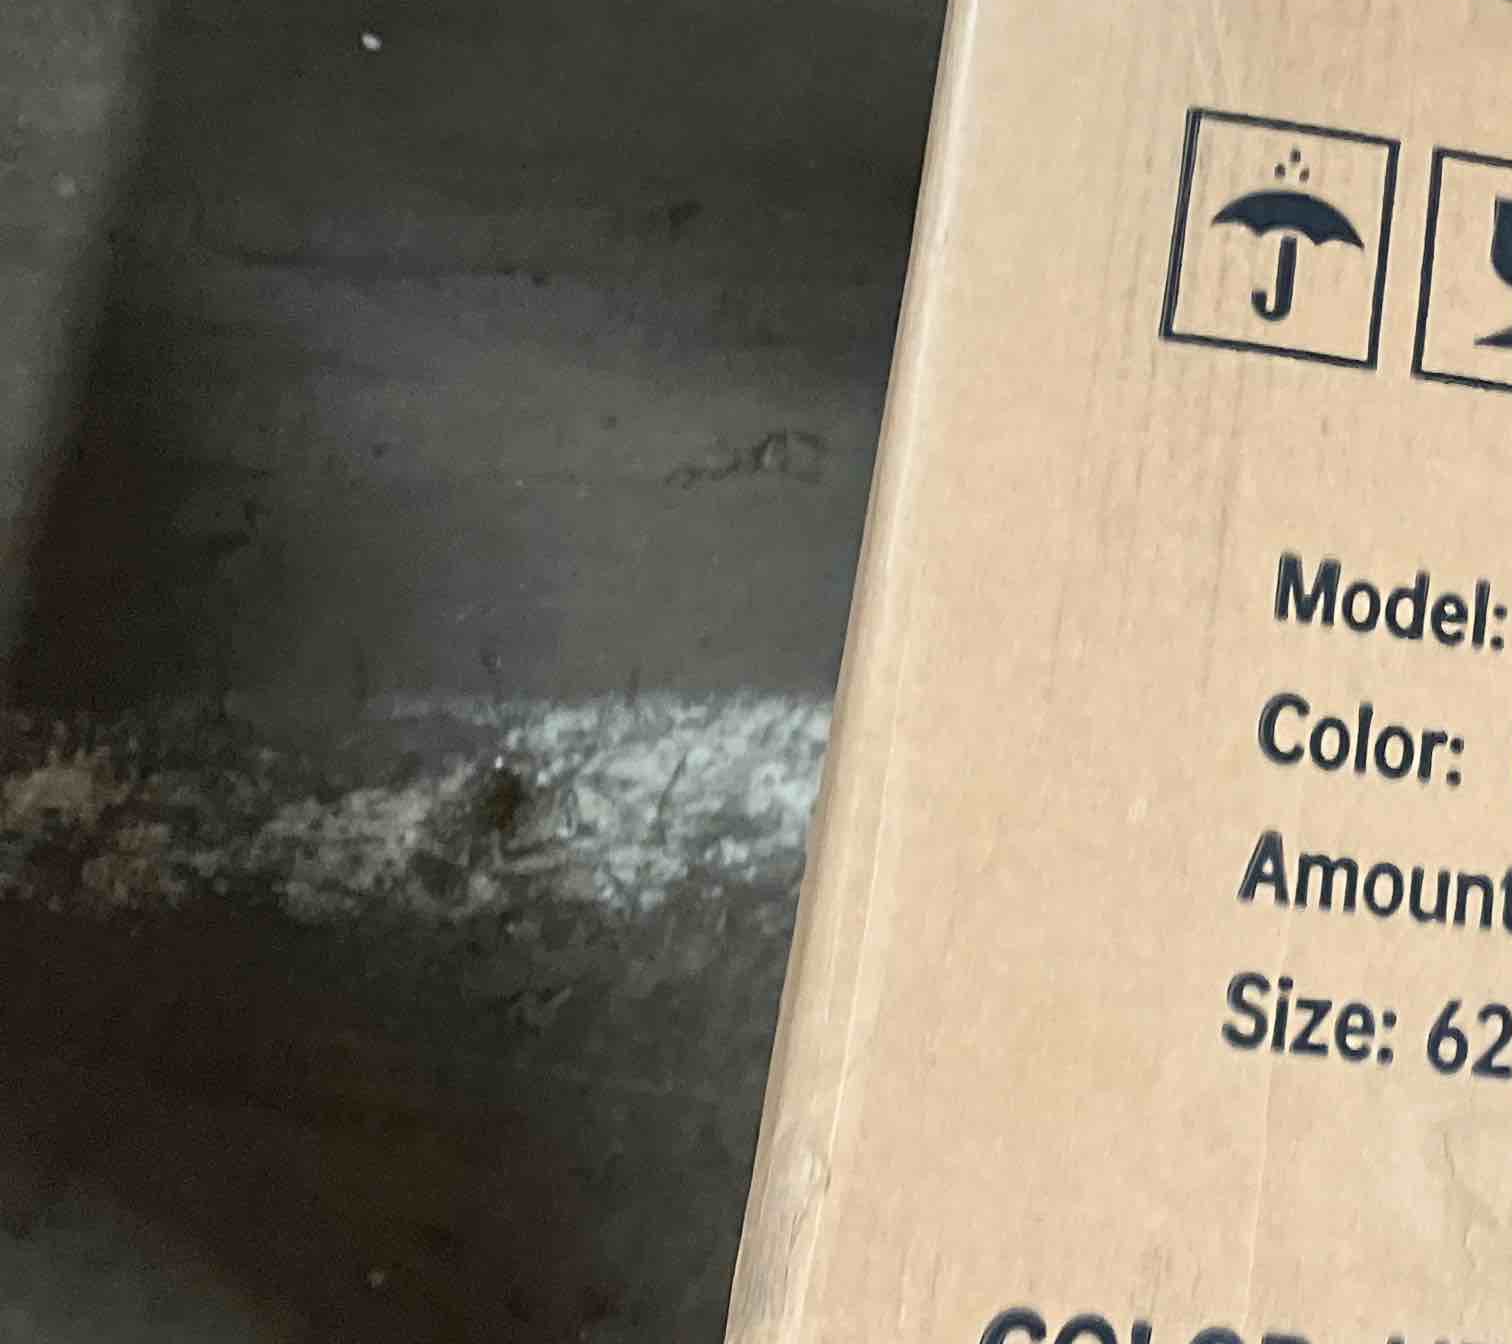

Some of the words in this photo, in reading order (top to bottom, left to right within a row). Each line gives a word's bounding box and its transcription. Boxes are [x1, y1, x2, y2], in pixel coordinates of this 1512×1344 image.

[1273, 550, 1508, 651] Model:
[1257, 692, 1465, 789] Color:
[1220, 971, 1399, 1067] Size:
